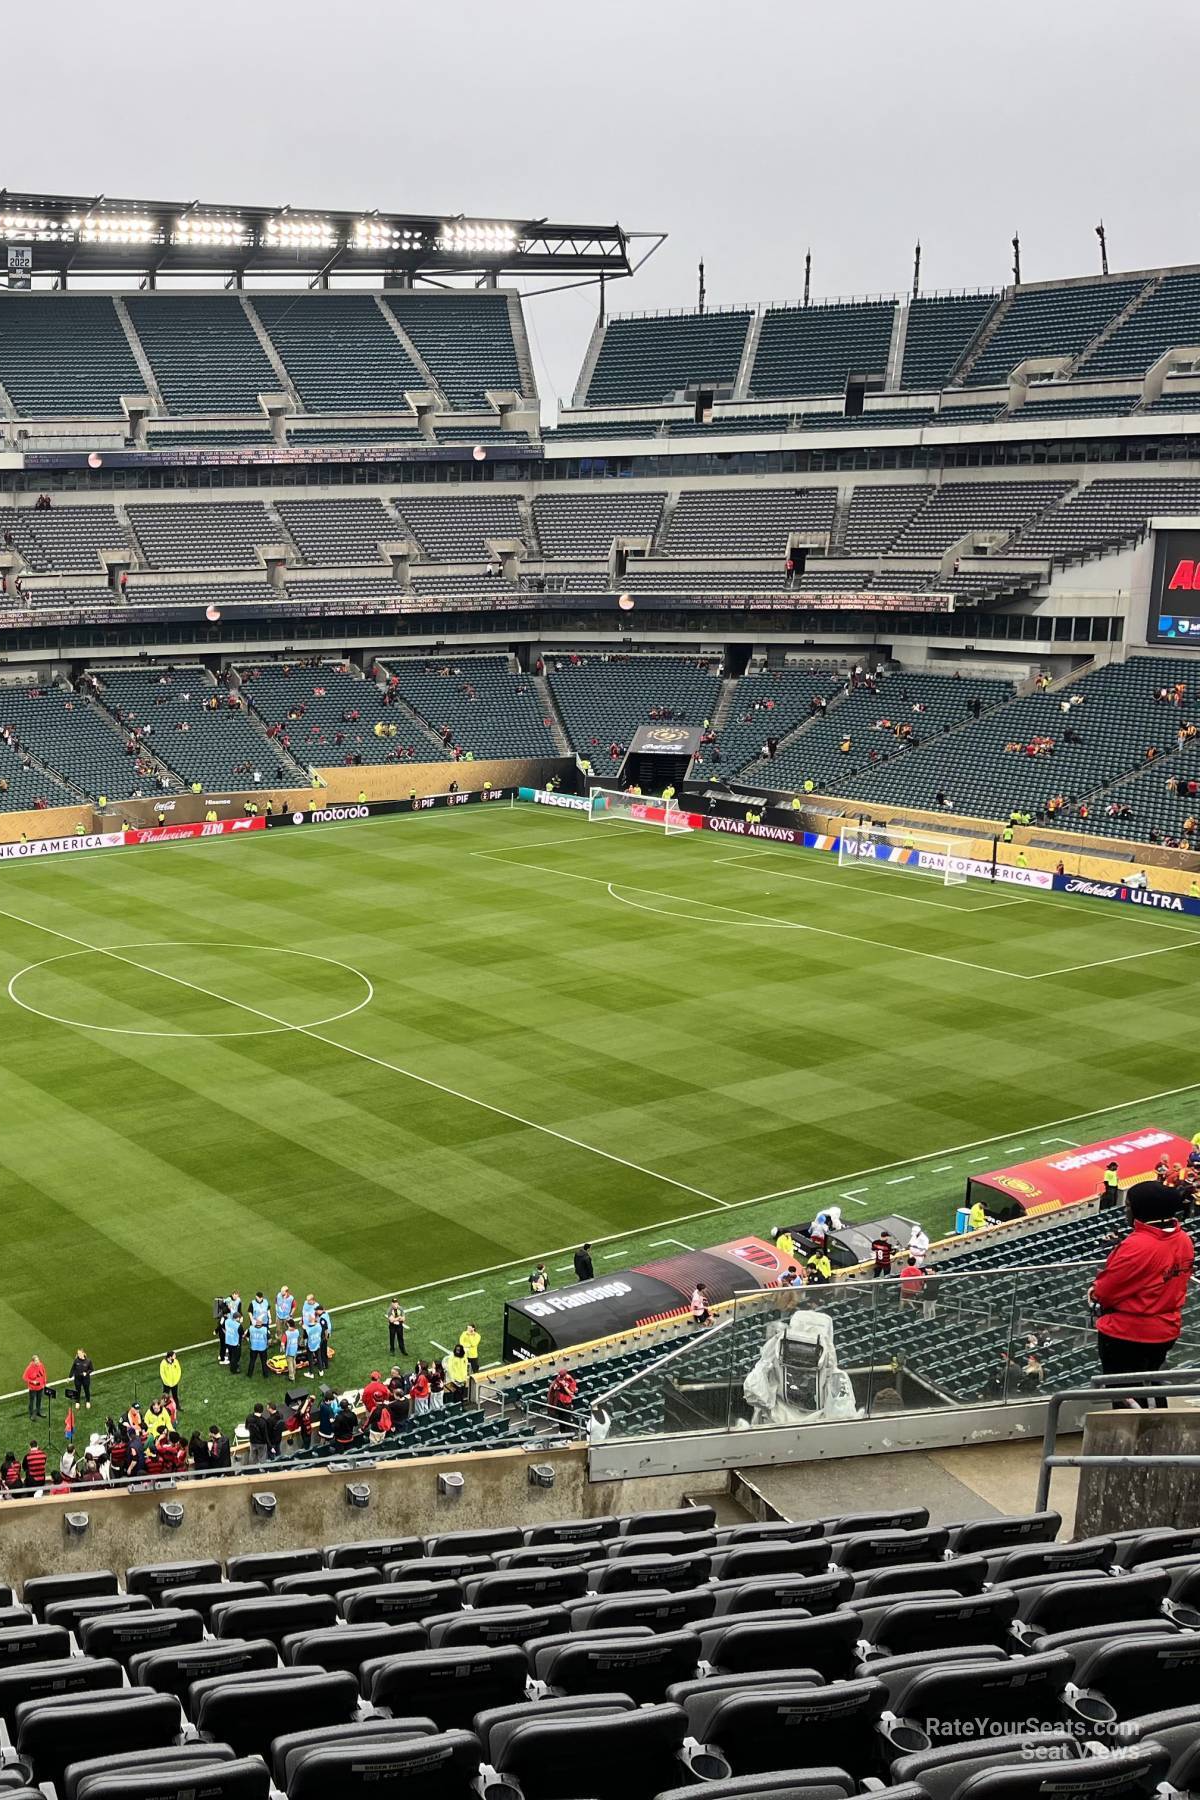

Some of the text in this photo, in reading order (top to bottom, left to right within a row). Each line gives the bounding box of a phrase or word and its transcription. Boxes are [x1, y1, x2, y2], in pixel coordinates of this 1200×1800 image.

[10, 258, 30, 267] 2022
[421, 799, 434, 808] PIF
[456, 794, 469, 804] PIF
[490, 790, 502, 800] PIF
[534, 790, 592, 811] Hisense
[311, 805, 369, 823] motorola
[136, 822, 224, 844] Budweiser ZERO
[709, 818, 795, 842] QATAR AIRWAYS
[19, 844, 35, 855] OF
[40, 836, 102, 853] AMERICA
[844, 839, 877, 858] VISA
[956, 862, 972, 873] OF
[974, 865, 1031, 882] AMERICA
[1065, 879, 1183, 911] Michelob ULTRA
[524, 1281, 632, 1317] CR Flamengo
